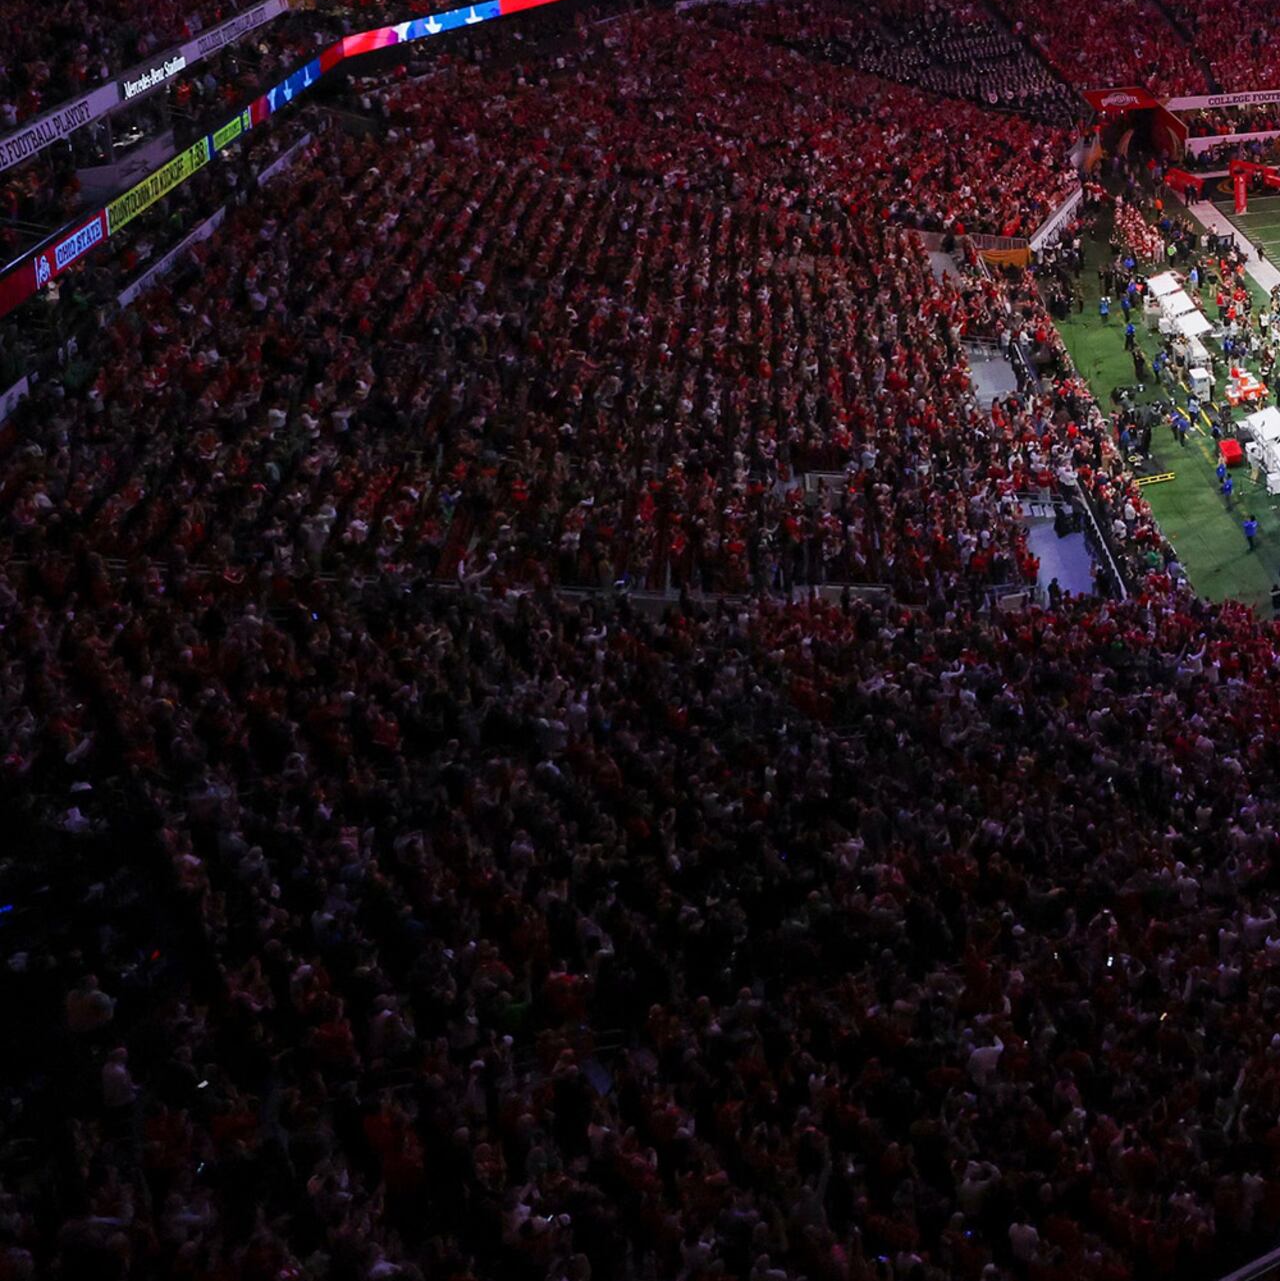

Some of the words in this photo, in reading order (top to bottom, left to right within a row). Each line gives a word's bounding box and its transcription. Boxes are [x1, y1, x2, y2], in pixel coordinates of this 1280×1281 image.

[123, 67, 165, 100] Mercedes-Benz
[164, 55, 187, 78] Stadium
[1208, 94, 1251, 106] COLLEGE
[8, 122, 55, 162] FOOTBALL
[53, 100, 92, 137] PLAYOFF
[109, 188, 150, 229] COUNTDOWN
[56, 236, 76, 269] OHIO
[76, 220, 103, 257] STATE
